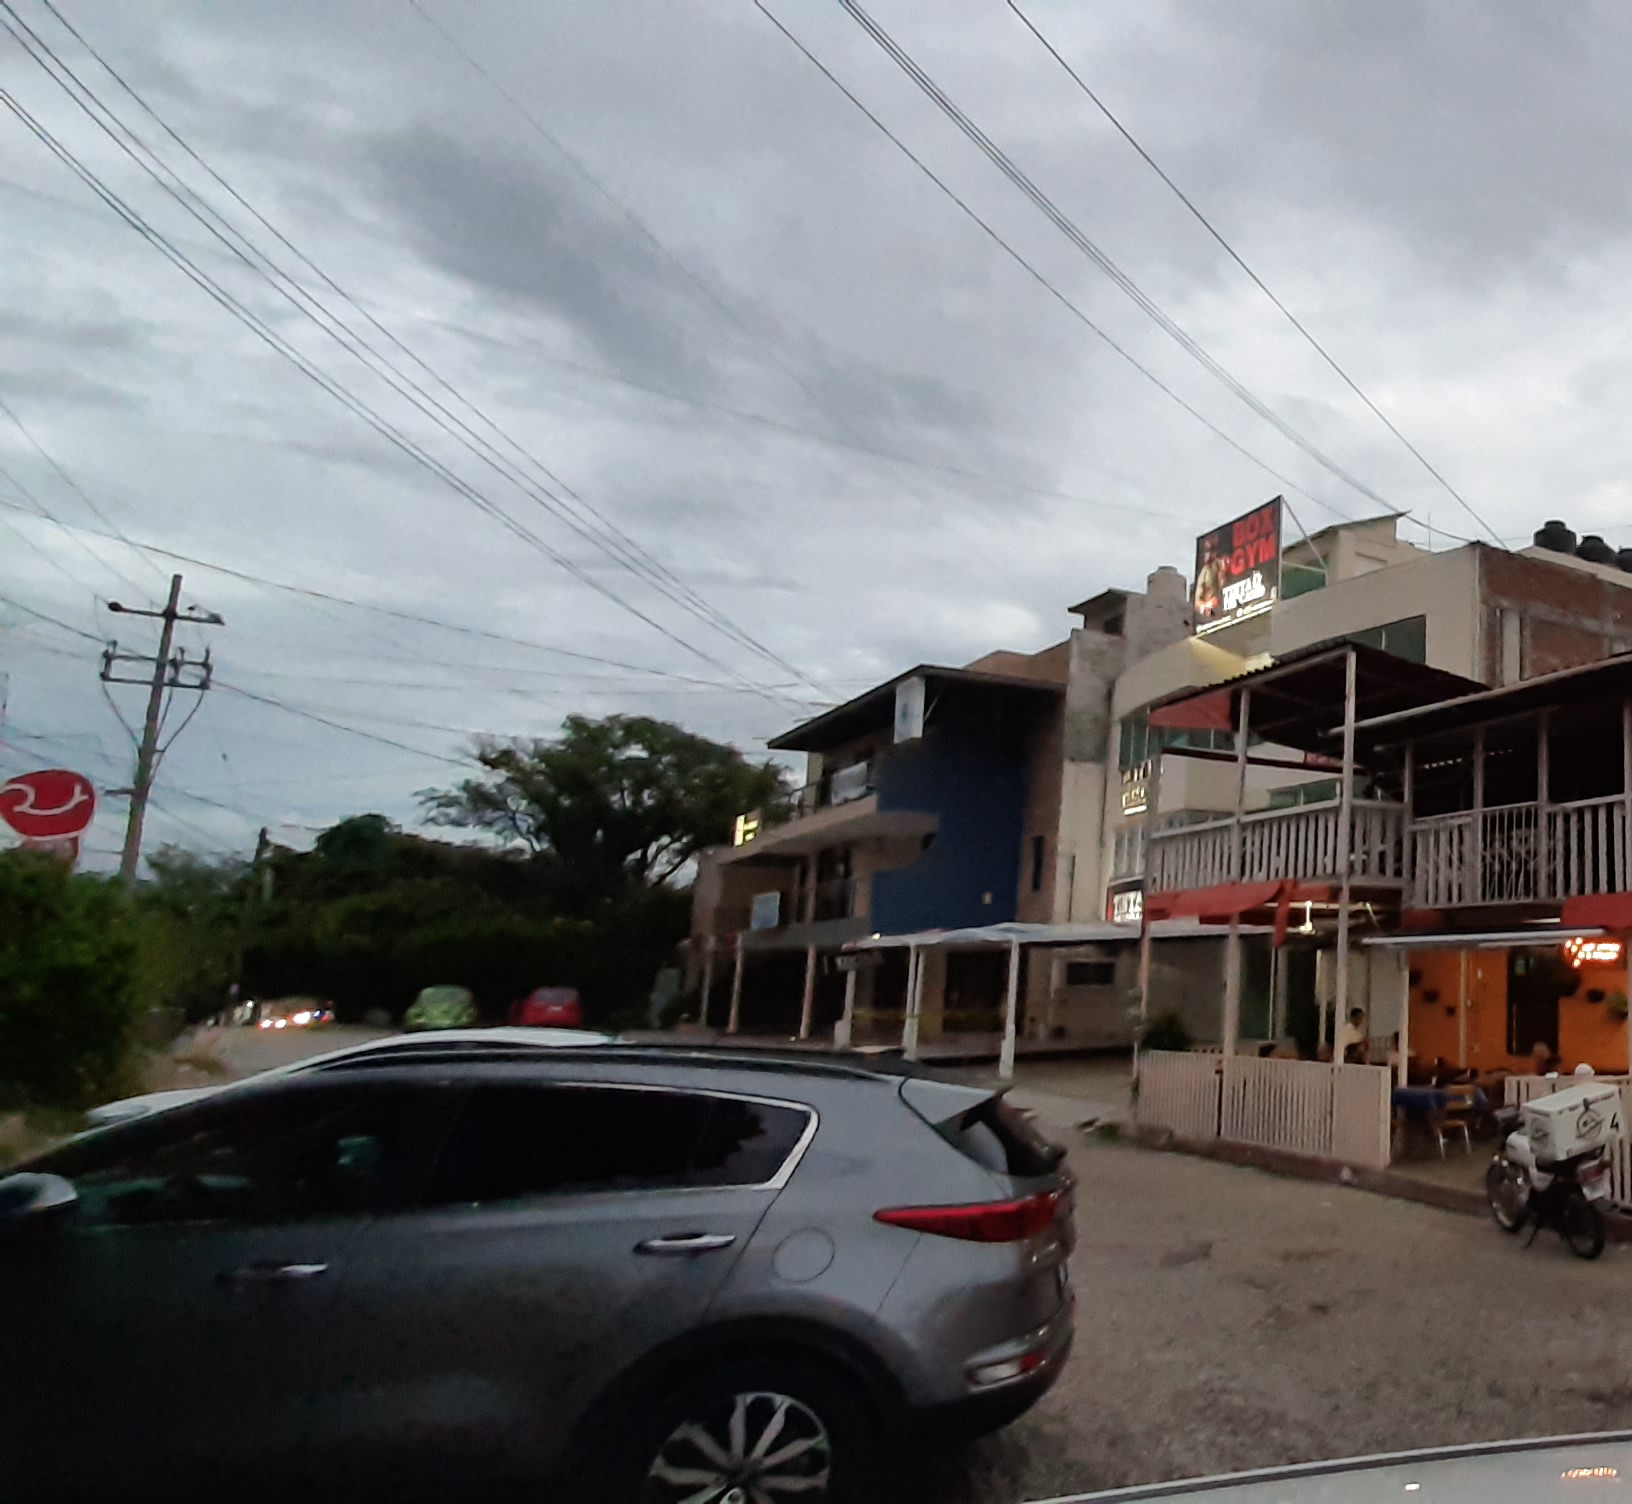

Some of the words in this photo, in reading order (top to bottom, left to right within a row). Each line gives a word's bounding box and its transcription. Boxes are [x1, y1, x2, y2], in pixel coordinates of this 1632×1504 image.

[1232, 507, 1275, 546] BOX
[1231, 536, 1276, 575] GYM
[1610, 1111, 1620, 1132] 4
